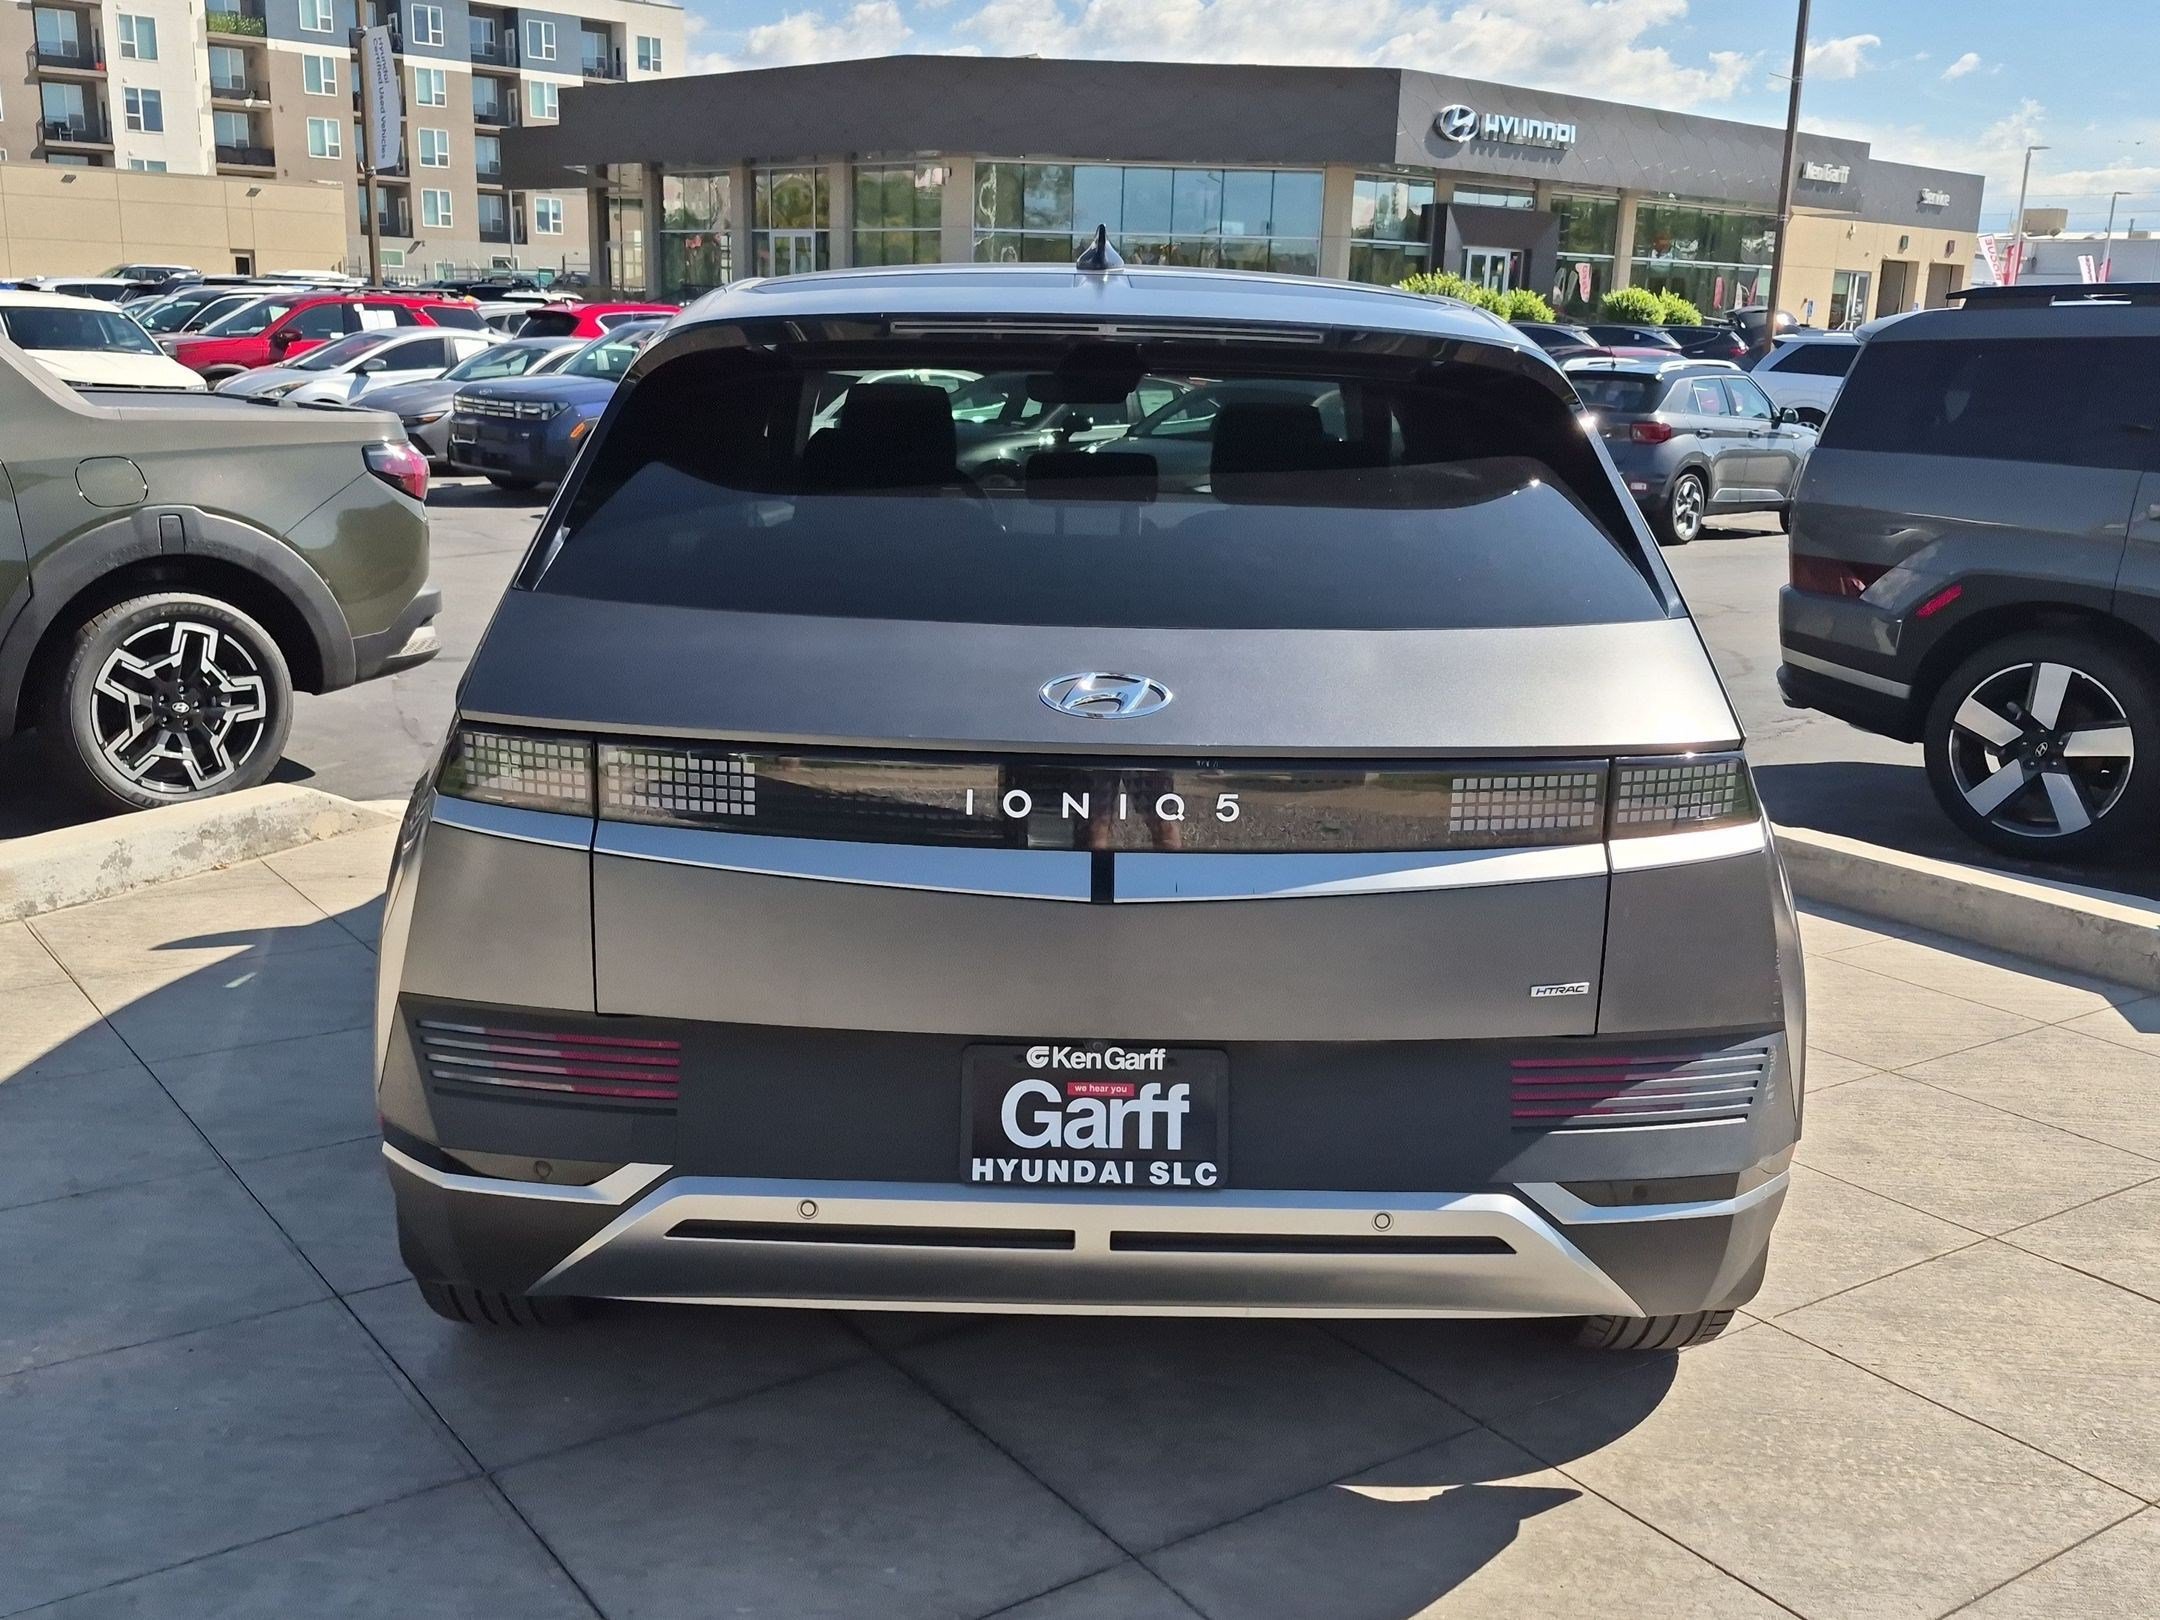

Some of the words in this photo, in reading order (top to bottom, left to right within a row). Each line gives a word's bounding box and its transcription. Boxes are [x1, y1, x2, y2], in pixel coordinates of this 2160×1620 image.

[378, 37, 389, 84] Hyundai
[373, 38, 382, 84] Certified
[380, 116, 388, 160] Vehicles
[1485, 113, 1576, 144] HYUNDAI
[965, 788, 1185, 822] IONIQ
[1216, 793, 1240, 822] 5
[1535, 985, 1585, 996] HTRAC
[1053, 1046, 1103, 1070] Ken
[1104, 1047, 1166, 1071] Garff
[1074, 1085, 1088, 1093] we
[1089, 1084, 1109, 1093] hear
[1110, 1085, 1127, 1095] you
[1001, 1078, 1190, 1151] Garff
[971, 1158, 1134, 1184] HYUNDAI
[1149, 1161, 1218, 1186] SLC
